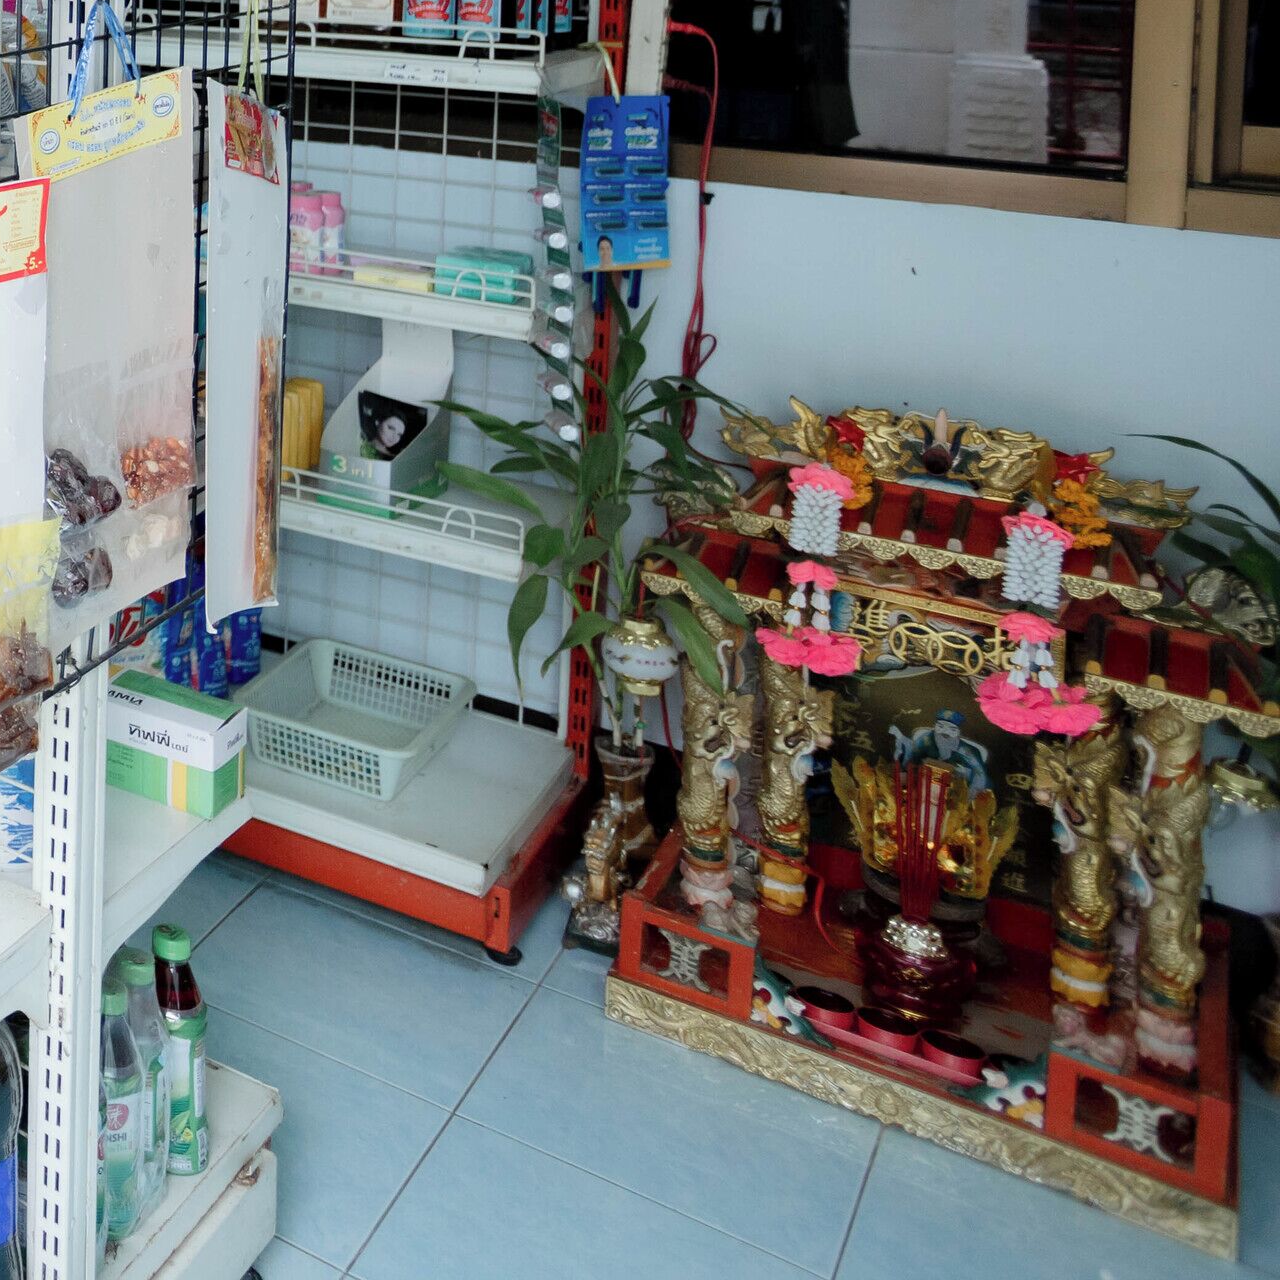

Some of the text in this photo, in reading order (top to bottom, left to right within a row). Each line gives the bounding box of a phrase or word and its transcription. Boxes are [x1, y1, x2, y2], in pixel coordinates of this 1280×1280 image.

[331, 454, 348, 474] 3
[128, 723, 171, 747] ทิฟฟี่
